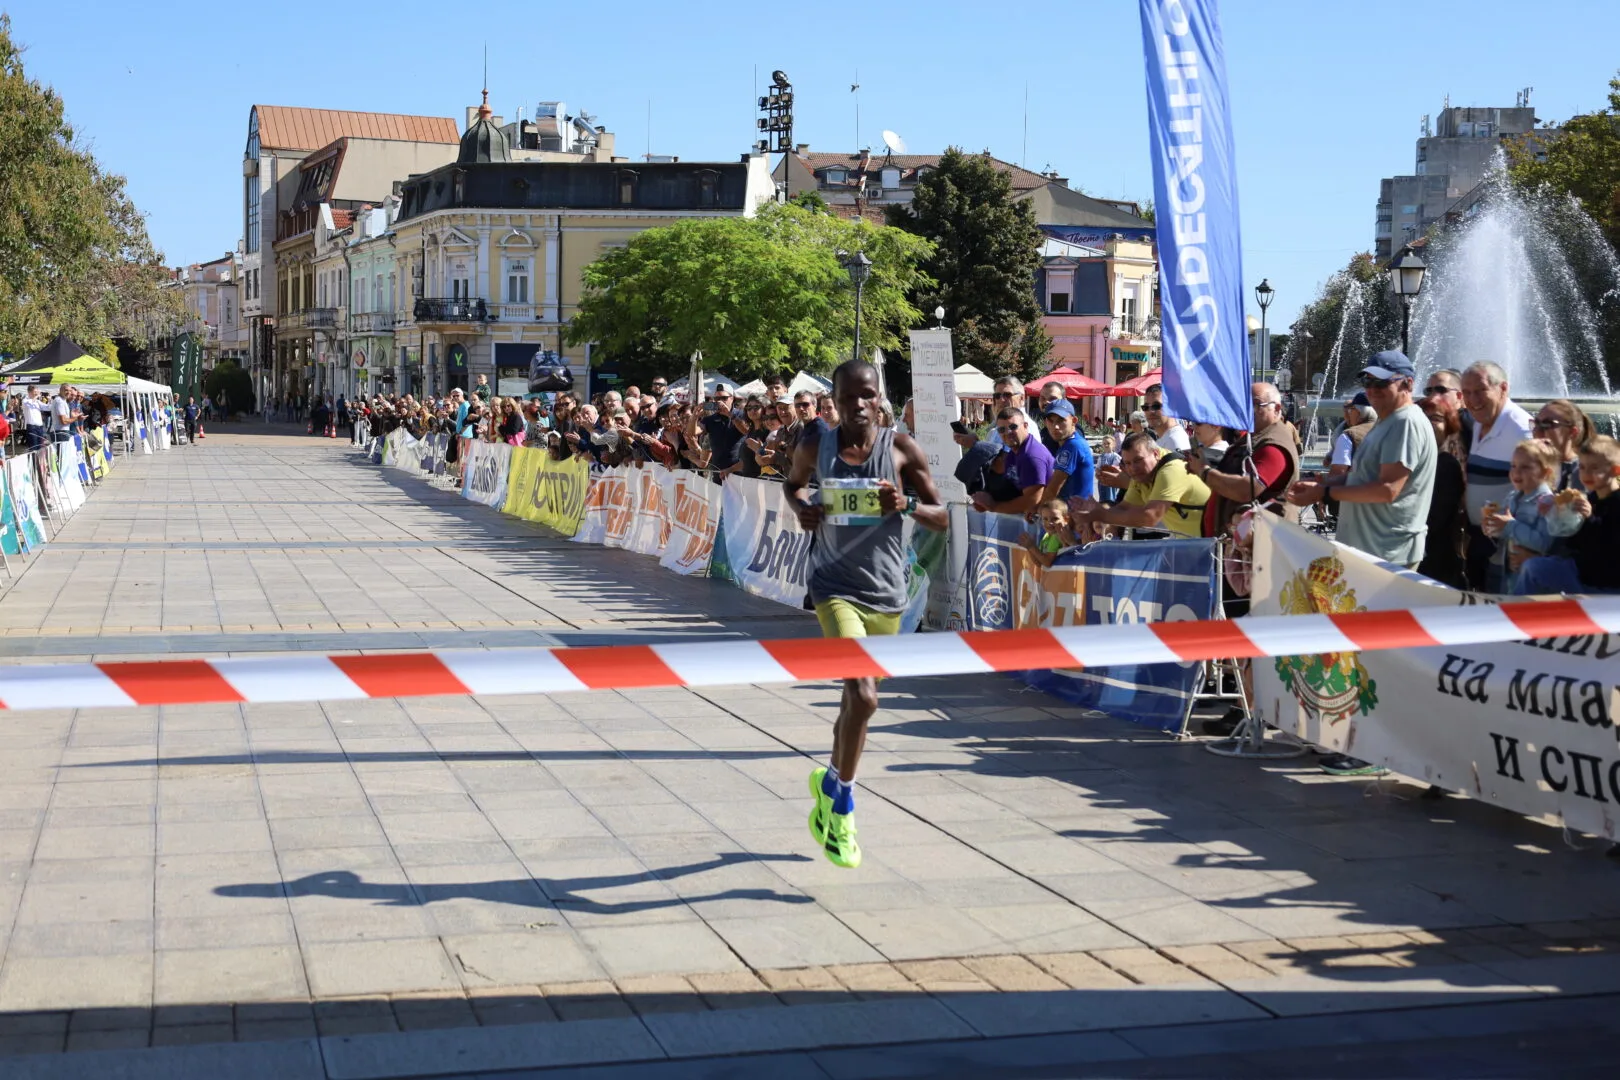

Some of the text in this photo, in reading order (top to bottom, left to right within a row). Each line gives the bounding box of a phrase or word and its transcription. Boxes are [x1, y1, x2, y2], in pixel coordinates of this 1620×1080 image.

[178, 340, 187, 385] DACIA
[841, 493, 858, 512] 18
[1437, 653, 1620, 743] на мла
[1489, 732, 1525, 783] и
